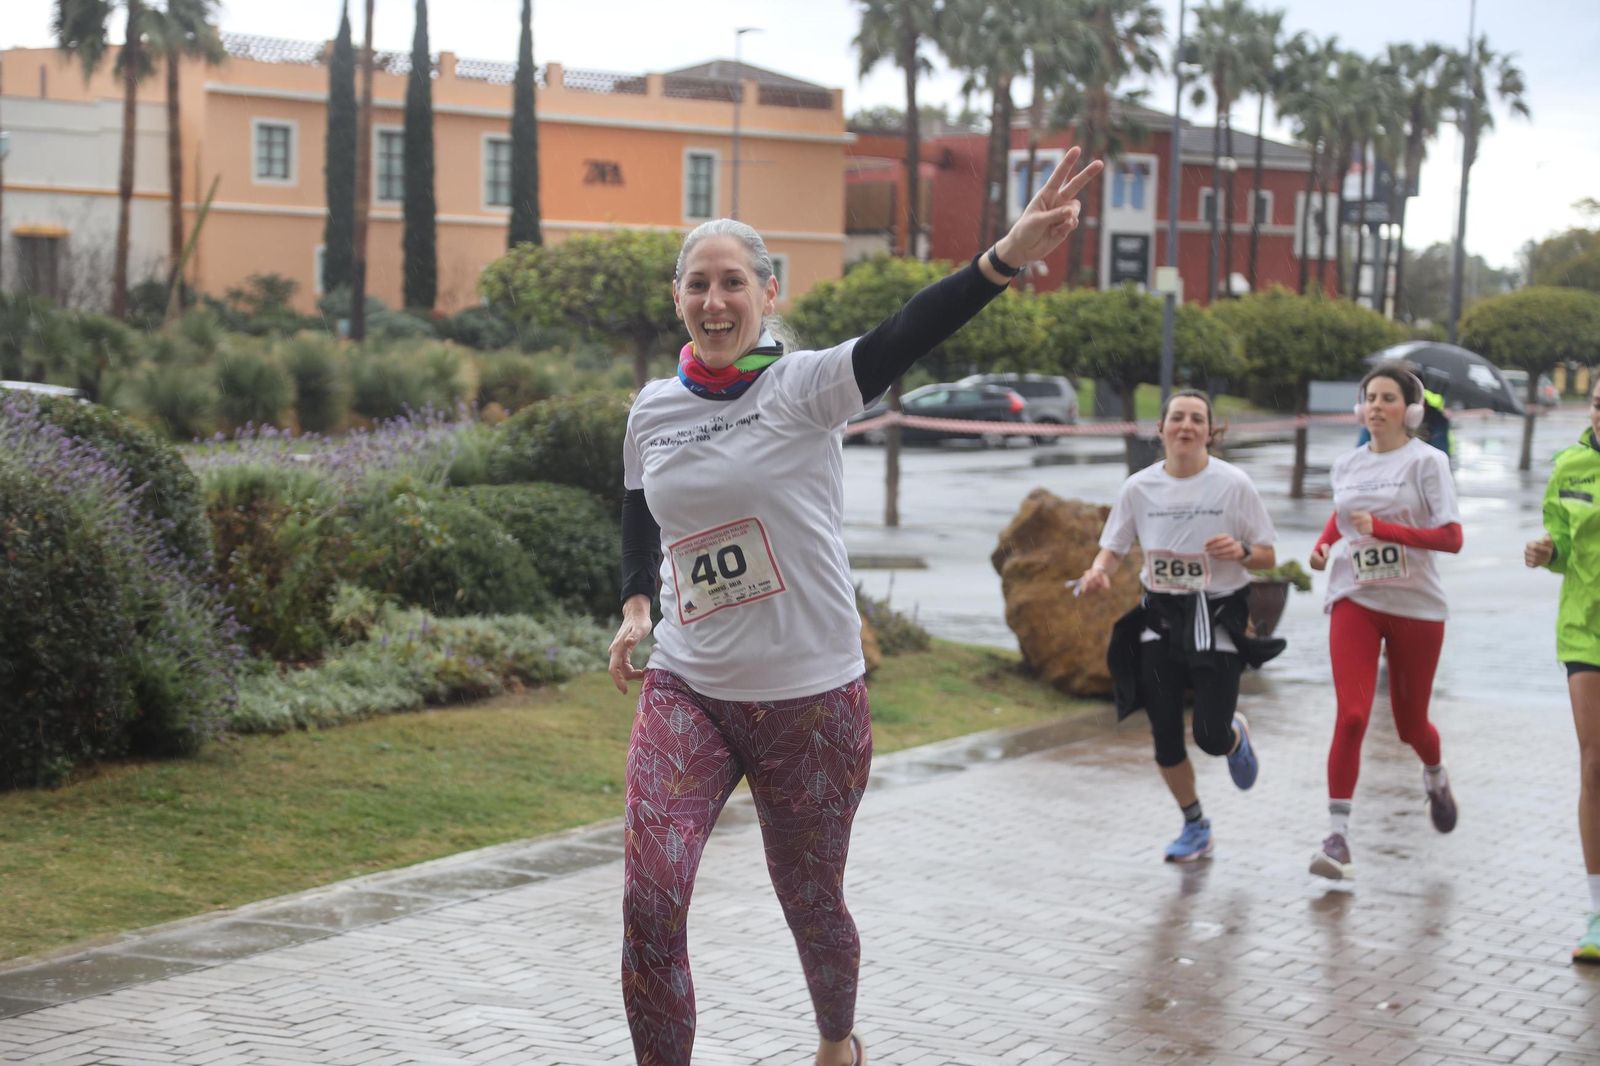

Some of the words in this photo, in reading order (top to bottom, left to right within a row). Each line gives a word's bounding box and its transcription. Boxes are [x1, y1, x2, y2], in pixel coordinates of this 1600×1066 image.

[691, 544, 747, 586] 40
[1154, 559, 1203, 577] 268
[1353, 546, 1399, 569] 130
